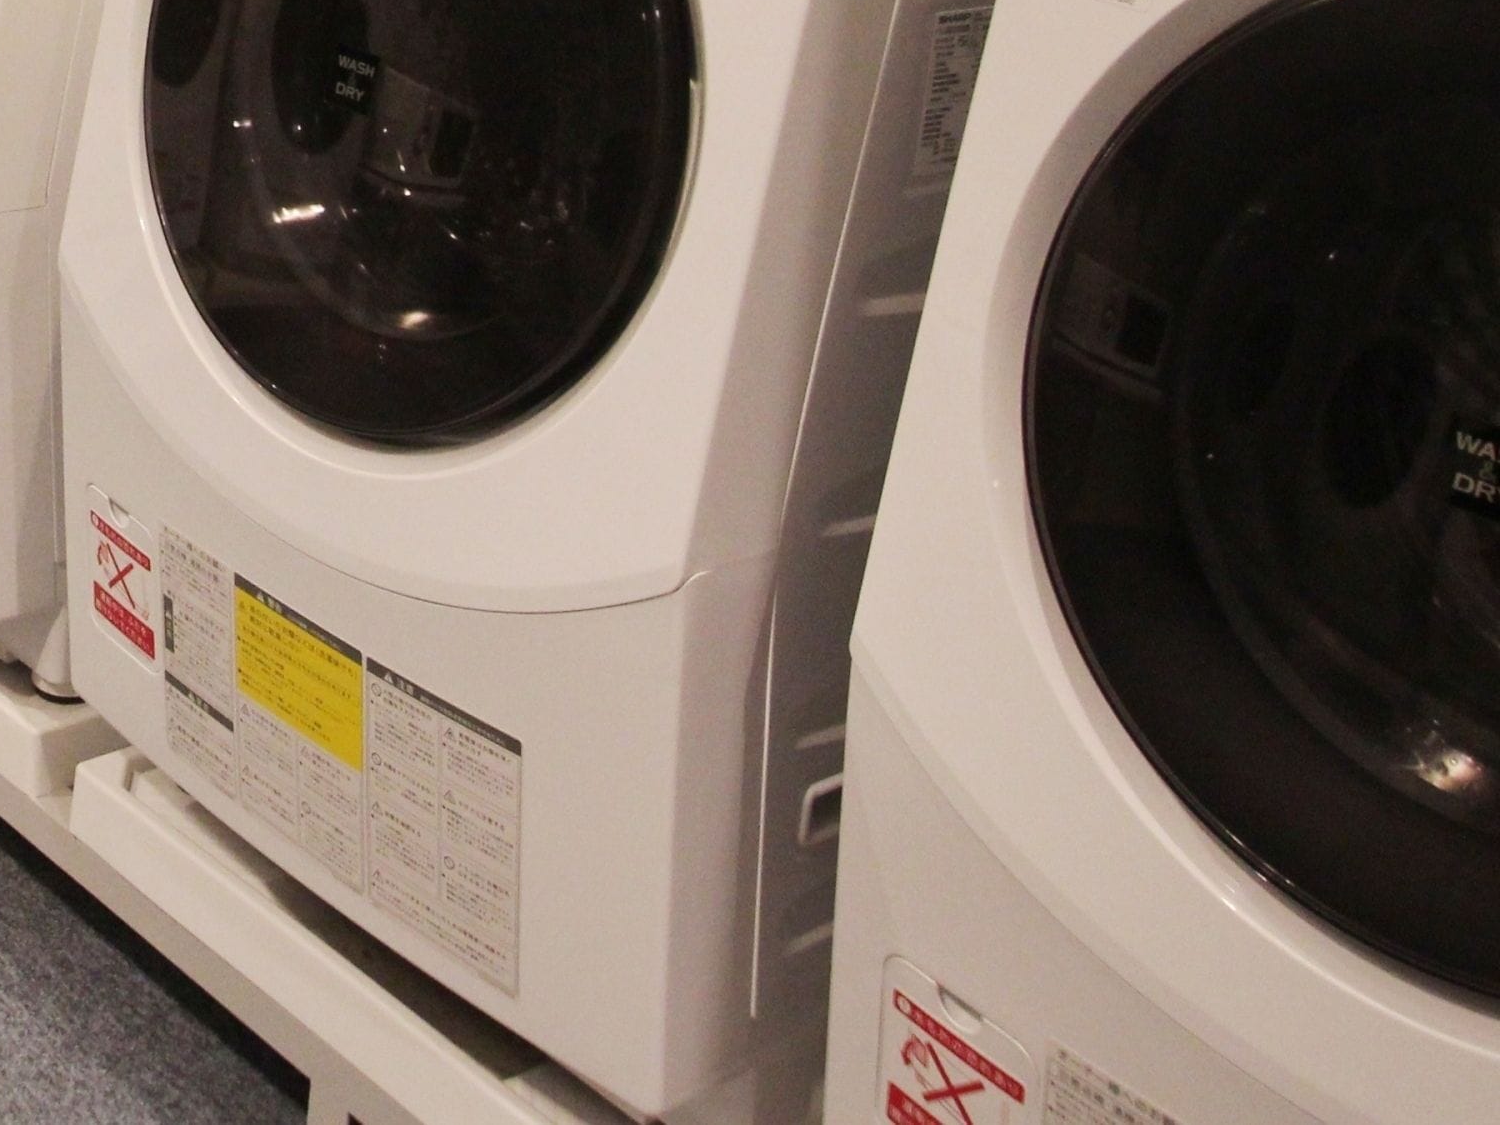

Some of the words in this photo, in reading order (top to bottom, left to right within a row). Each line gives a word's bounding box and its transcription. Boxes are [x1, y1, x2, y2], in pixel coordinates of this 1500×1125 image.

[337, 53, 376, 78] WASH
[334, 81, 366, 103] DRY
[1456, 430, 1500, 463] WA
[1452, 471, 1500, 504] DR
